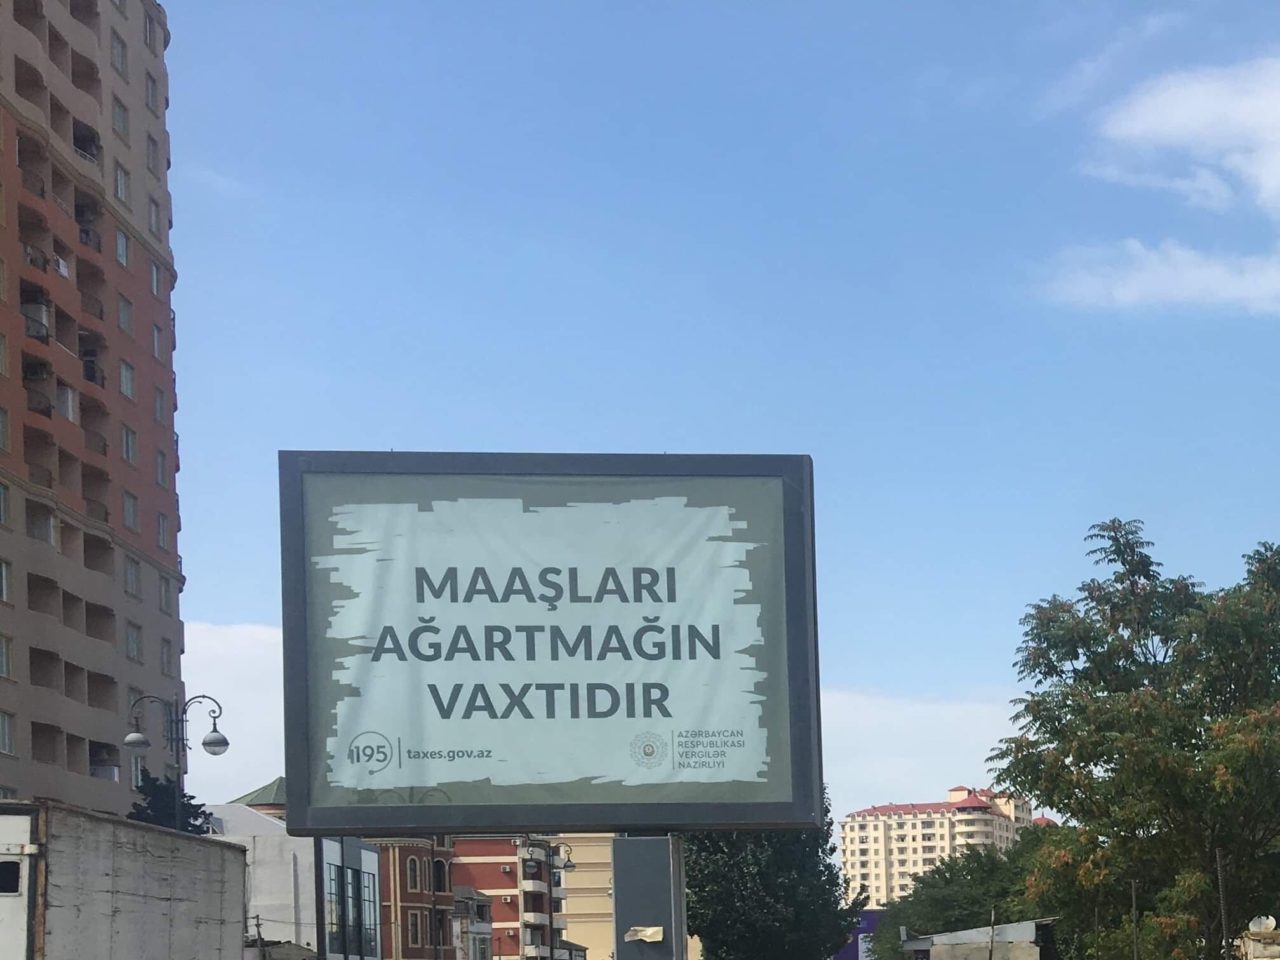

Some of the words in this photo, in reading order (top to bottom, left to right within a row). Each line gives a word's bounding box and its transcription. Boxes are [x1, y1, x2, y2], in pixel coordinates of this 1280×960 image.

[416, 566, 677, 611] MAAŞLARI
[371, 616, 721, 661] AĞARTMAĞIN
[427, 682, 672, 720] VAXTIDIR
[677, 729, 744, 739] AZƏRBAYCAN
[353, 745, 388, 763] 195
[406, 748, 492, 762] taxes.gov.az
